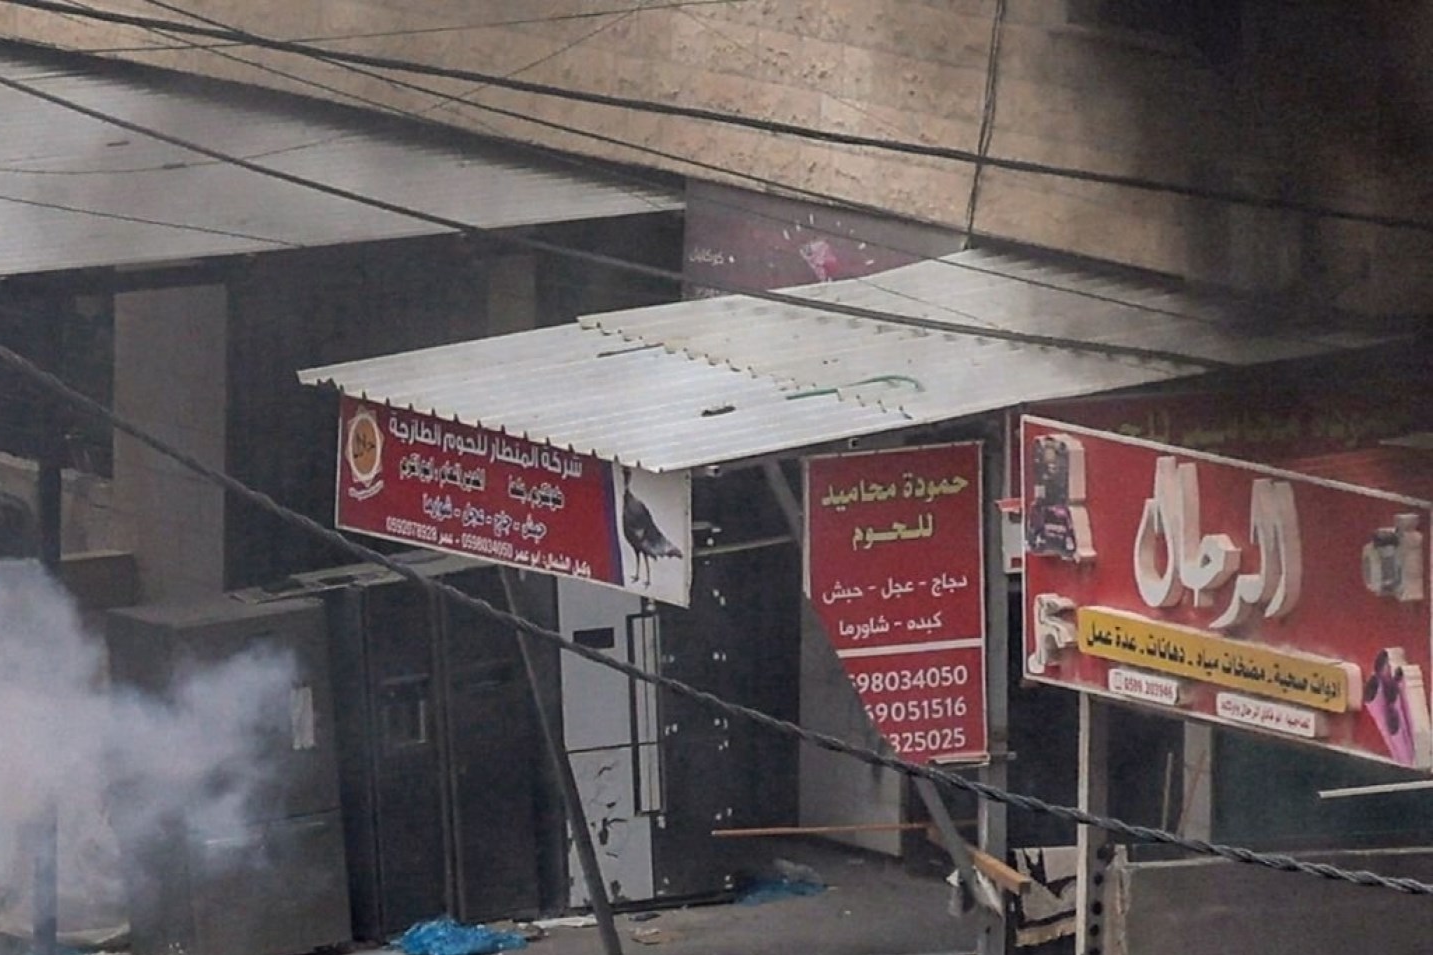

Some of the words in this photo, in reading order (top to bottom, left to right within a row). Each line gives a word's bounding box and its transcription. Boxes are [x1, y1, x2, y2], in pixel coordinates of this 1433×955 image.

[389, 410, 442, 447] الطازجة
[443, 432, 487, 456] للحوم
[489, 436, 539, 470] المنطار
[541, 445, 583, 479] شركة
[821, 479, 897, 511] محاميد
[903, 472, 969, 503] حمودة
[852, 512, 934, 551] للحوم
[822, 580, 863, 604] حبش
[881, 577, 915, 599] عجل
[931, 572, 968, 597] دجاج
[838, 614, 890, 640] شاورما
[906, 610, 943, 634] كبده
[848, 665, 968, 695] 98034050
[884, 727, 966, 753] 325025
